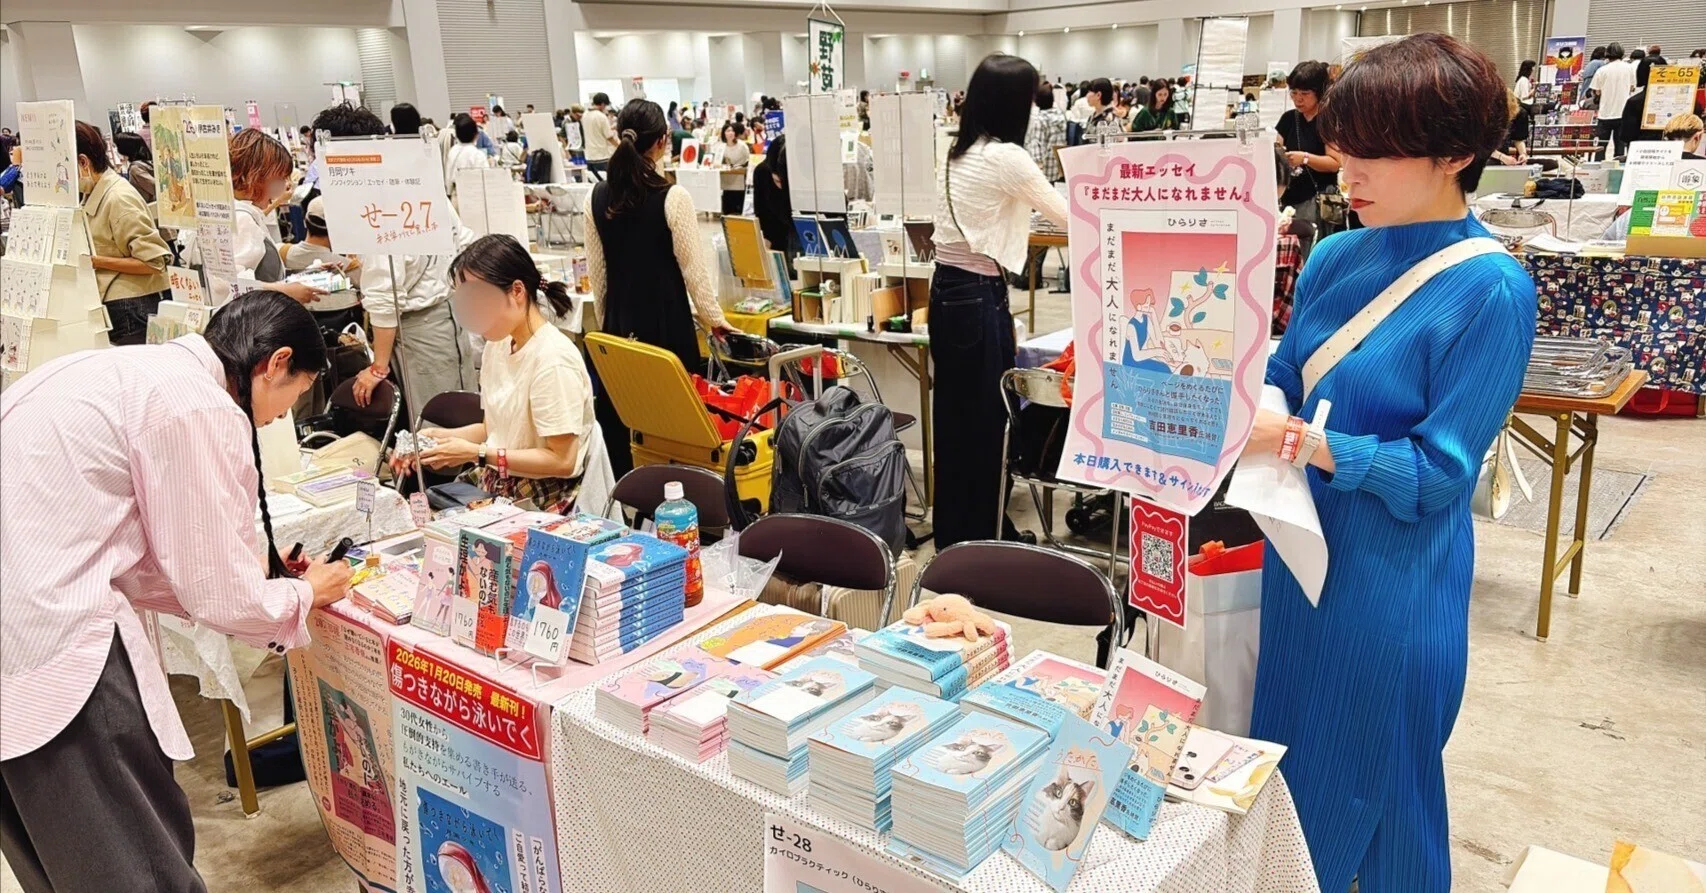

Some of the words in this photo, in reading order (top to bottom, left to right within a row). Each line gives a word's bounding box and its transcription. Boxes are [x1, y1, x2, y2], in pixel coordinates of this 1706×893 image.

[328, 166, 356, 177] 月岡ツキ
[1119, 163, 1196, 179] 最新エッセイ
[1083, 186, 1251, 203] 『まだまだ大人になれません』
[1167, 217, 1208, 228] ひらりさ
[1105, 222, 1120, 390] まだまだ大人になれません
[454, 612, 473, 629] 1760
[533, 621, 559, 641] 1760
[549, 641, 559, 653] 円
[395, 648, 483, 698] 2026年1月20日発売
[490, 690, 526, 719] 最新刊!
[390, 662, 533, 750] 傷つきながら泳いでく
[400, 707, 448, 740] 30代女性から
[402, 756, 468, 796] 私たちへのエール
[770, 824, 813, 853] せ-28
